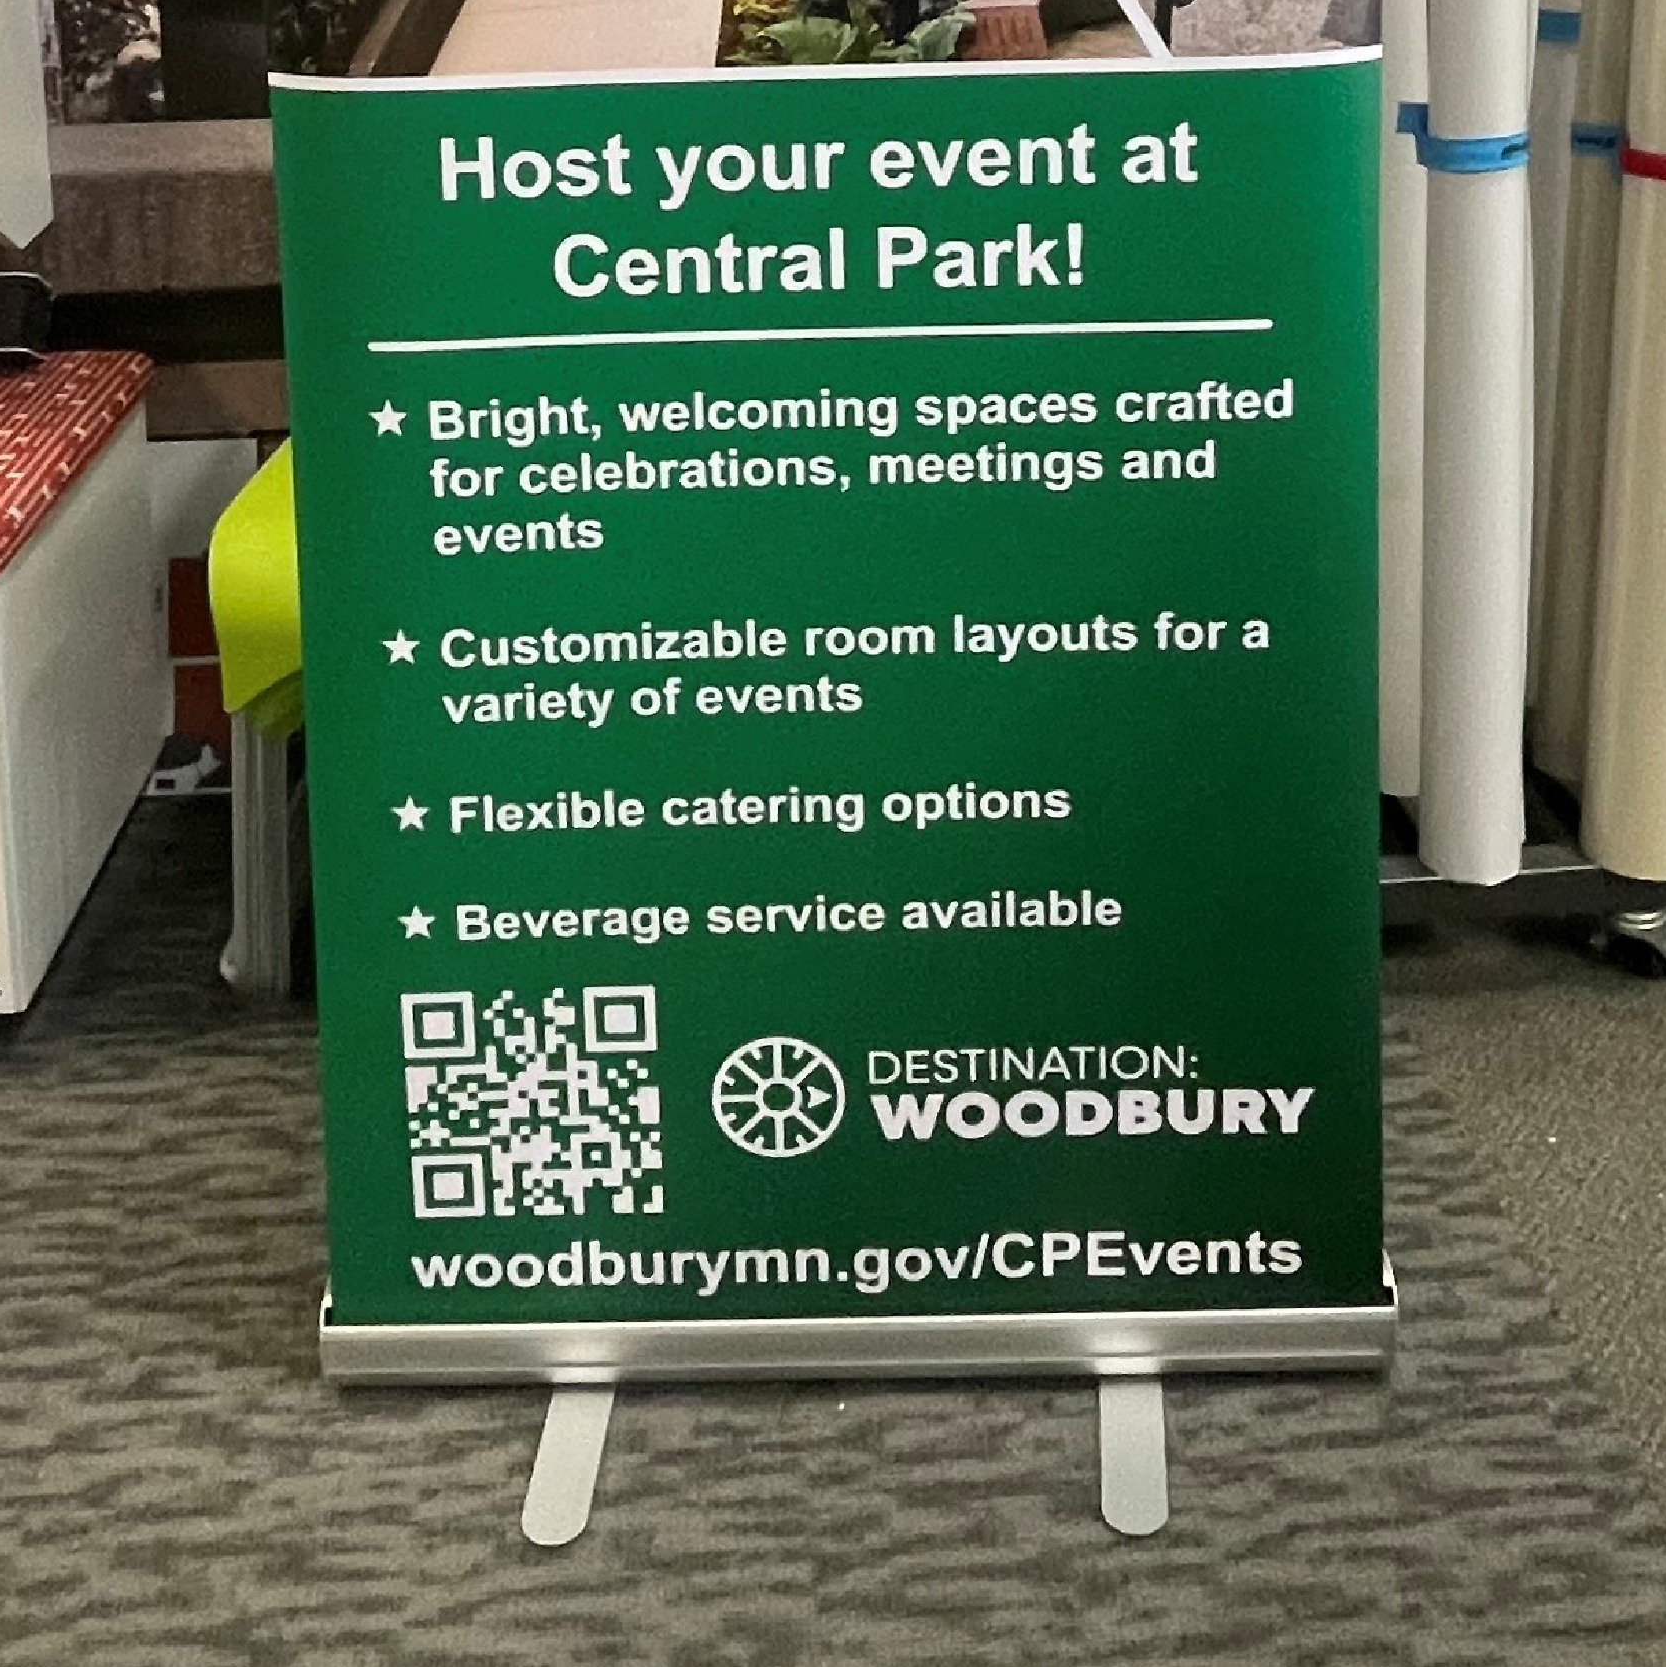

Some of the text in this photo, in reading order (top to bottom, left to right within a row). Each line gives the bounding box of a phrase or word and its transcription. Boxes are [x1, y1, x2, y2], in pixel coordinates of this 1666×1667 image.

[441, 122, 1198, 210] Host your event at
[554, 223, 1082, 297] Central Park!
[429, 378, 1293, 447] Bright, welcoming spaces crafted
[430, 440, 1215, 497] for celebrations, meetings and
[434, 513, 603, 555] events
[441, 612, 1268, 667] Customizable room layouts for a
[442, 676, 862, 728] variety of events
[451, 782, 1070, 833] Flexible catering options
[457, 890, 1121, 944] Beverage service available
[868, 1046, 1197, 1084] DESTINATION:
[871, 1088, 1314, 1139] WOODBURY
[411, 1231, 1301, 1296] woodburymn.gov/CPEvents
